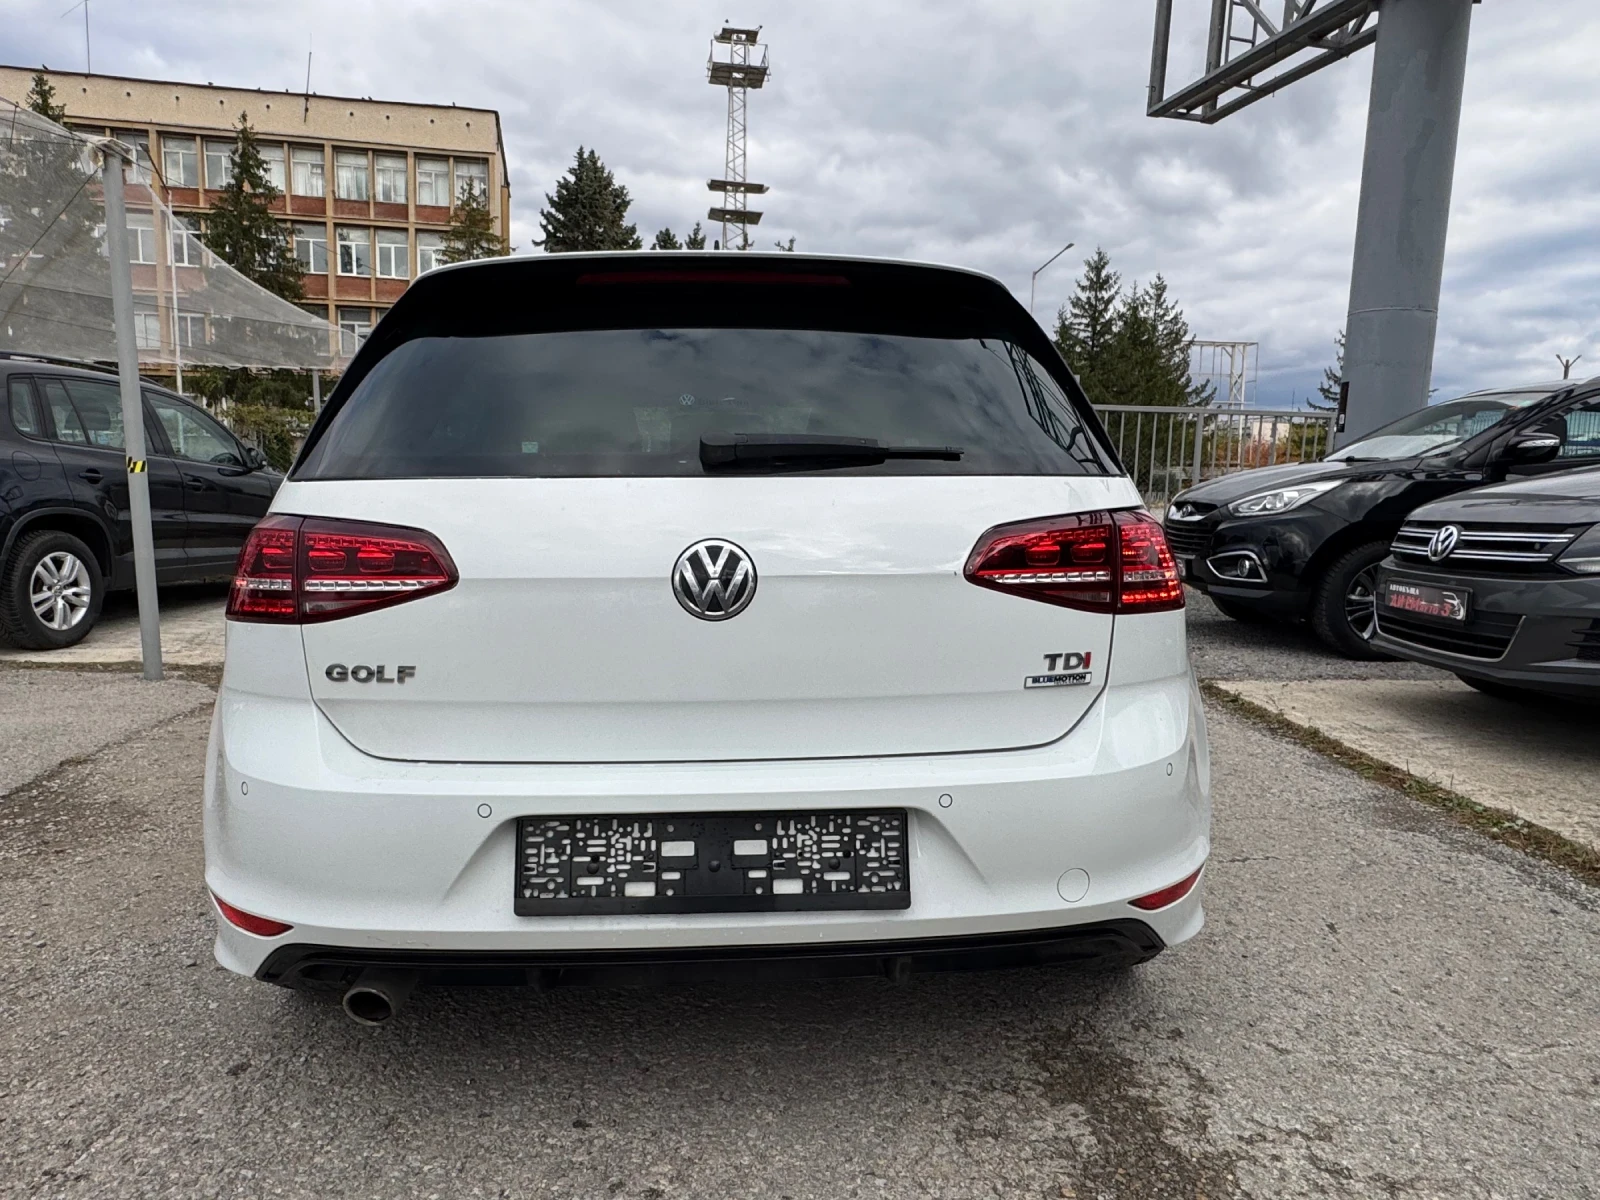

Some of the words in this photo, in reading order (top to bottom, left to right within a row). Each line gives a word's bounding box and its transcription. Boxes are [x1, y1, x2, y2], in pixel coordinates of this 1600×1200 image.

[673, 539, 756, 620] VW
[1043, 651, 1092, 671] TDI
[325, 663, 416, 684] GOLF
